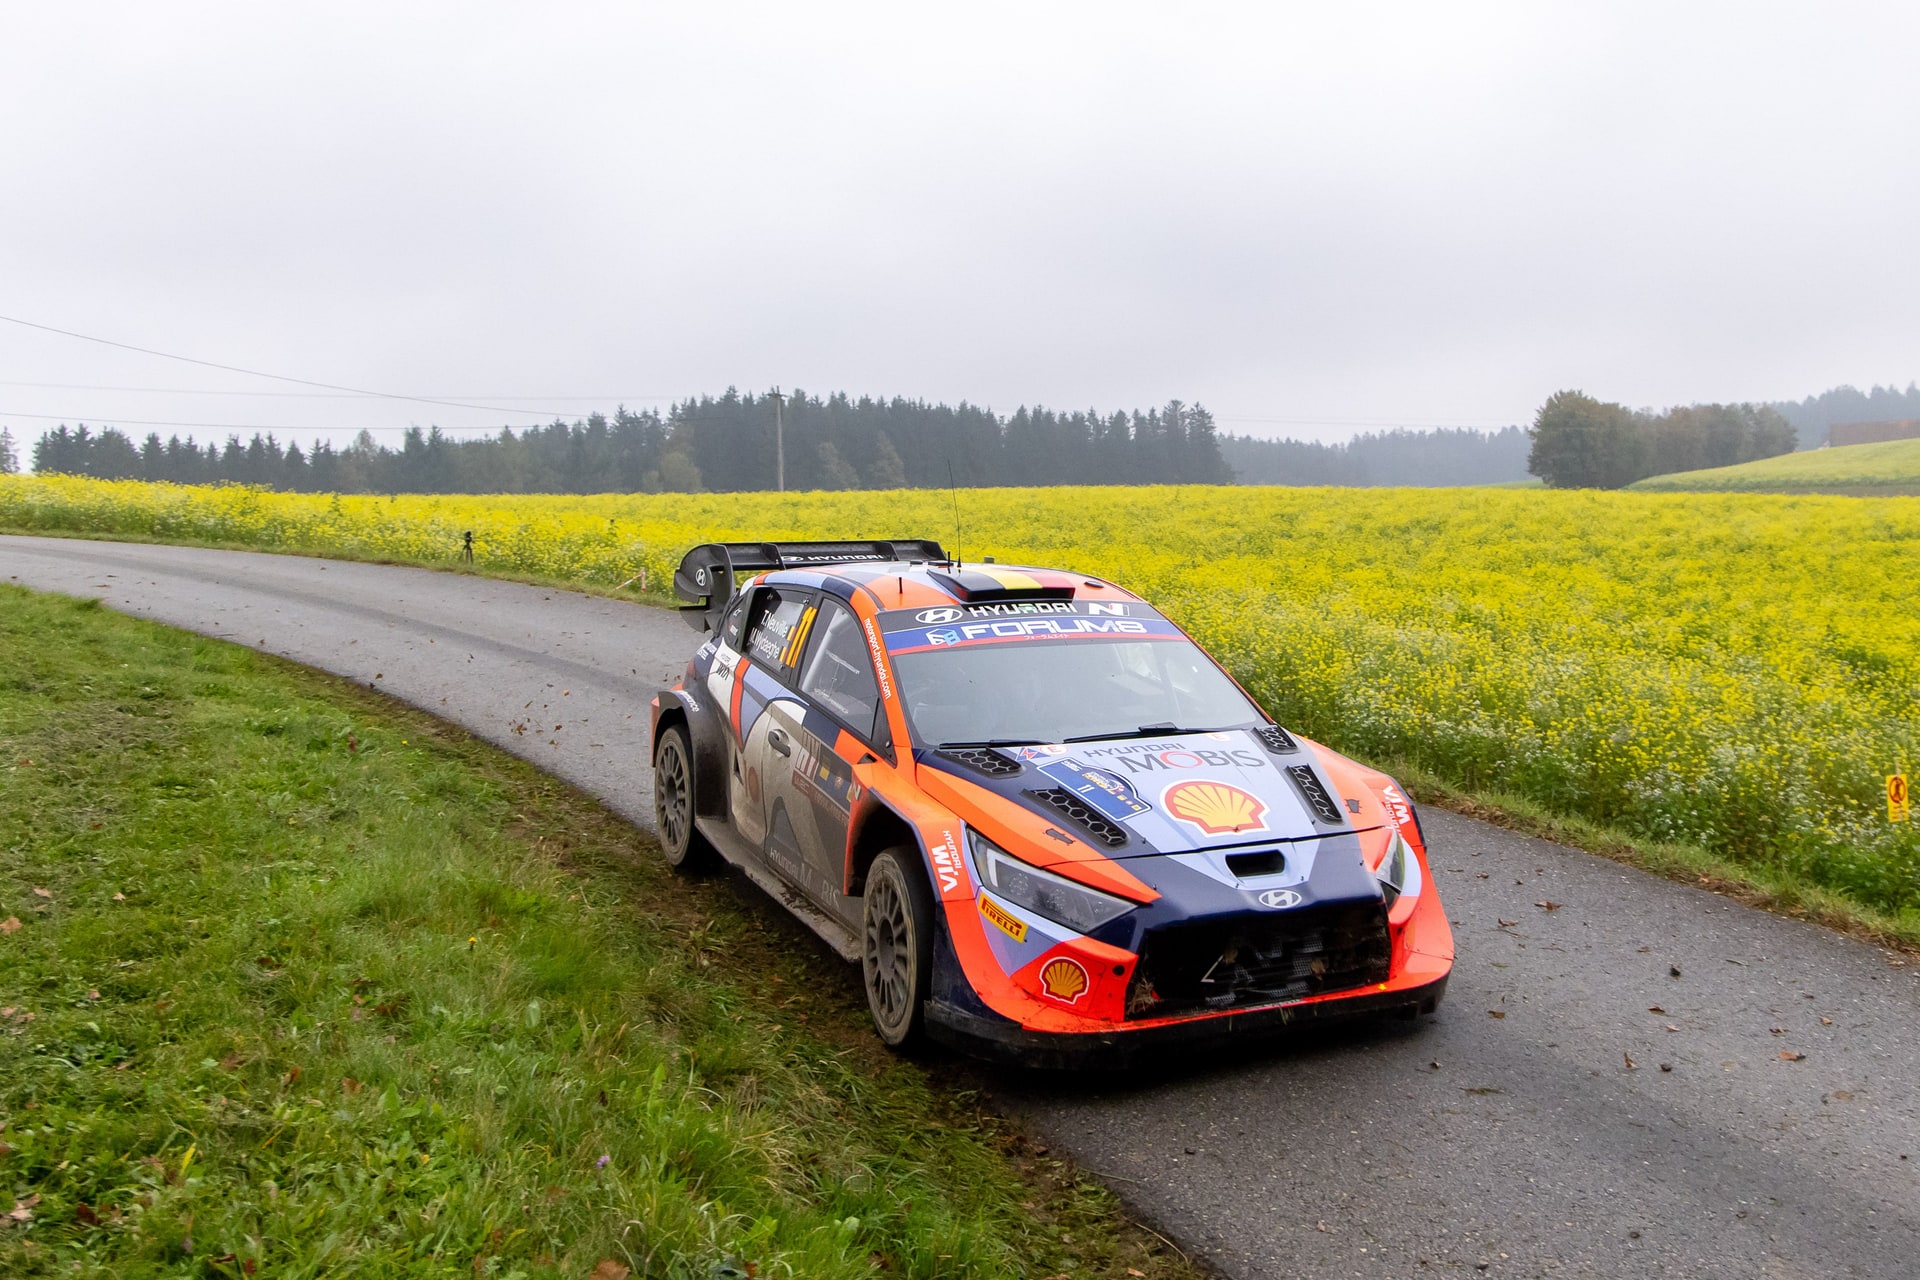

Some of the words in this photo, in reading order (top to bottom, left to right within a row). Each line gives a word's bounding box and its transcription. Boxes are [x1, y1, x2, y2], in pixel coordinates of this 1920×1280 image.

[966, 602, 1078, 618] HYUNDAI
[785, 606, 818, 669] 11
[960, 620, 1148, 640] FORUM8
[864, 617, 891, 700] motorsport.hyundai.com
[1083, 743, 1186, 758] HYUNDAI
[1115, 750, 1265, 774] MOBIS
[1077, 784, 1096, 793] 11
[1383, 785, 1411, 825] WIA
[931, 845, 959, 893] WIA
[943, 830, 962, 869] HYUNDAI
[800, 863, 841, 908] MBIS
[981, 898, 1023, 937] PIRELLI
